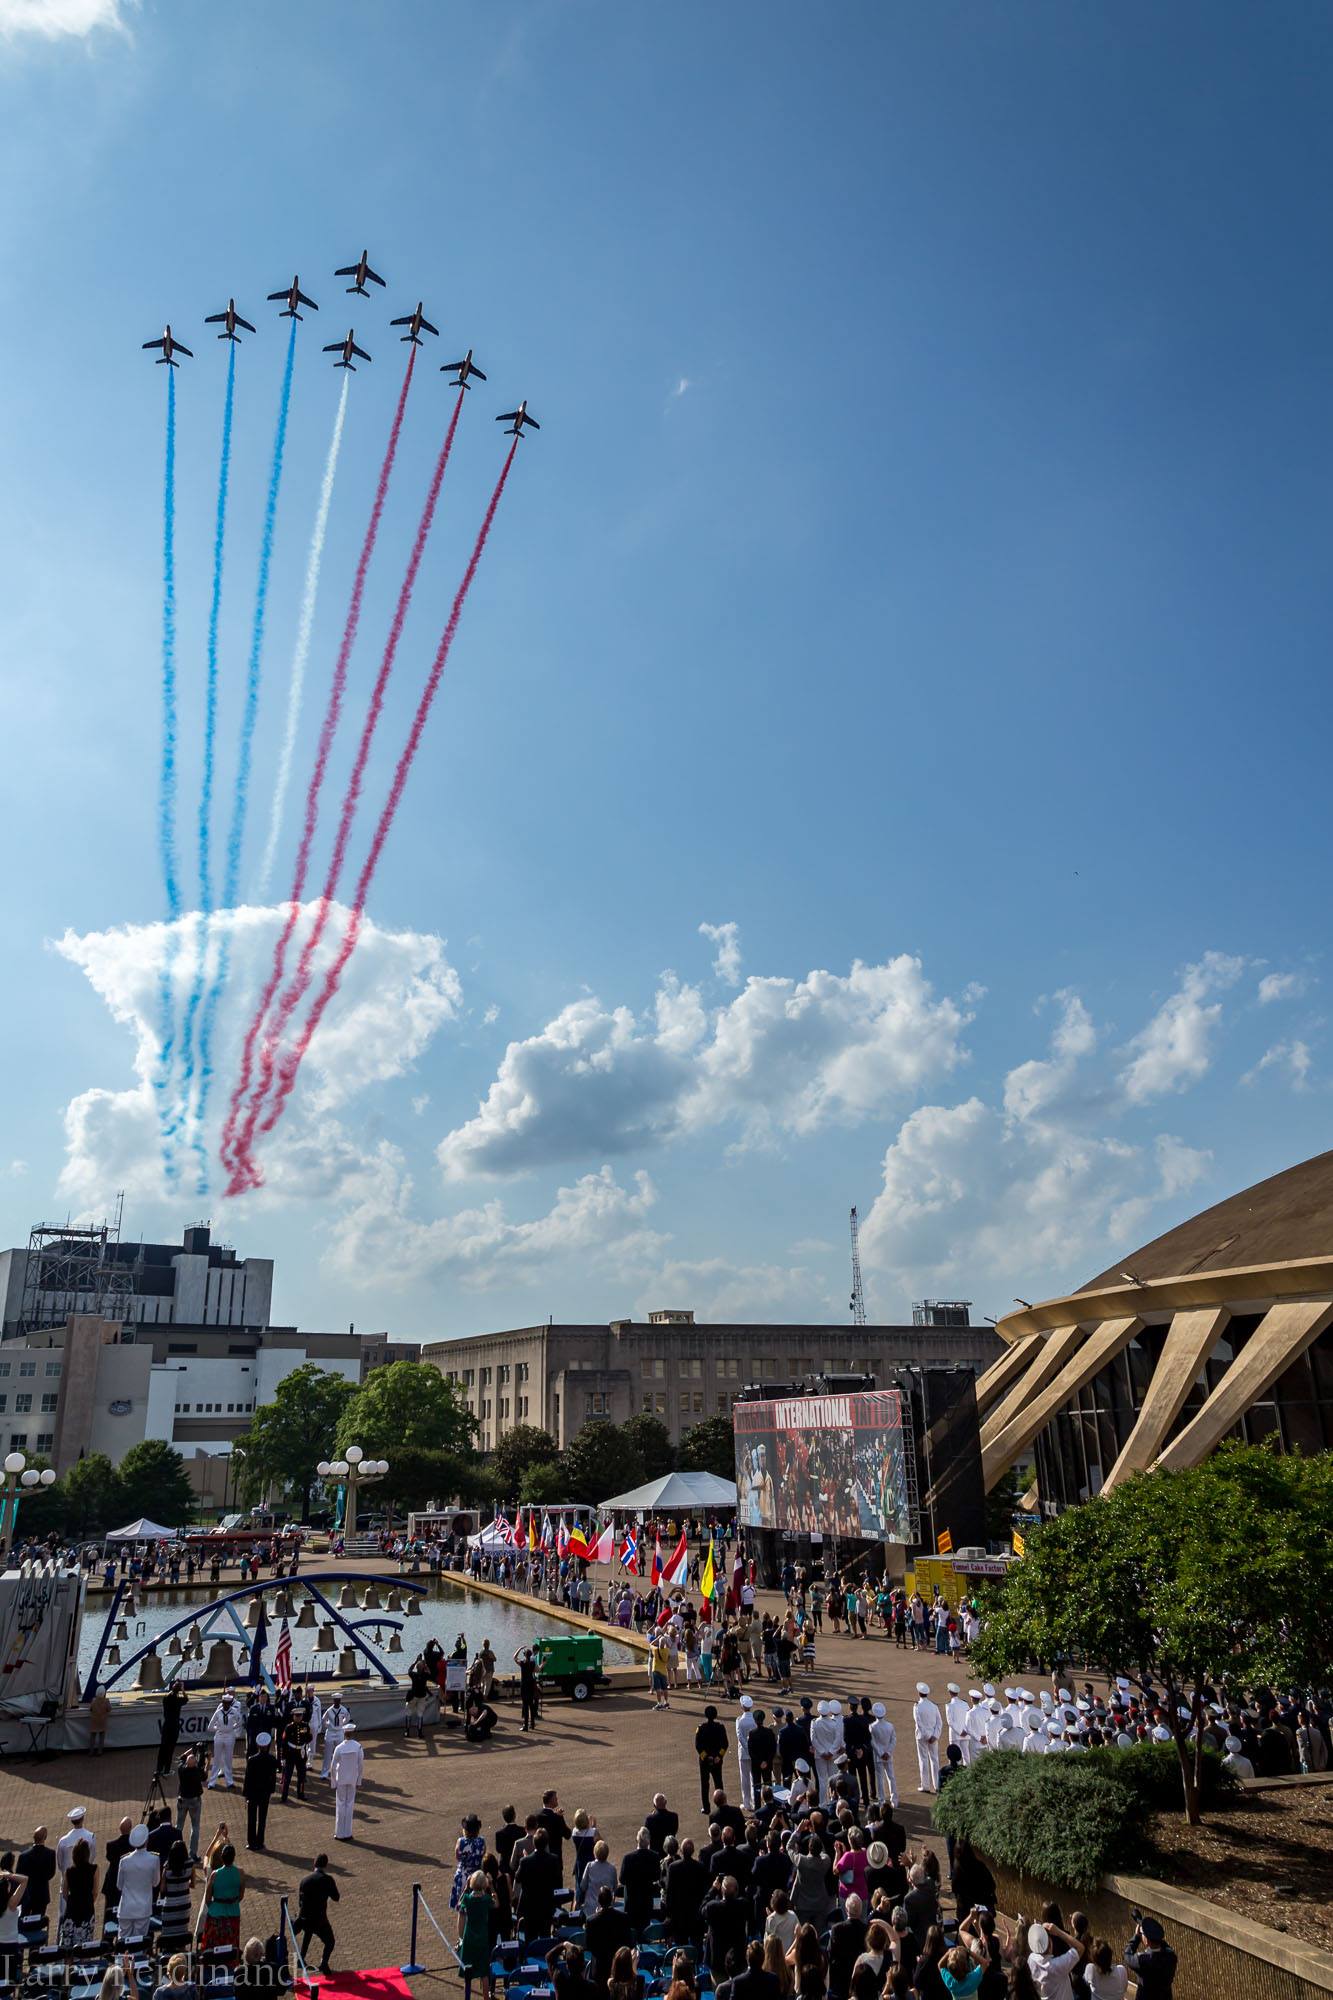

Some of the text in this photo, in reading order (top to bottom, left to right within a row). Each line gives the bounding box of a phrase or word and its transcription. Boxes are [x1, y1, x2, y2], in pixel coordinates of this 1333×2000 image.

[775, 1398, 852, 1429] INTERNATIONAL
[970, 1563, 983, 1571] Cake
[984, 1563, 1005, 1574] Factory
